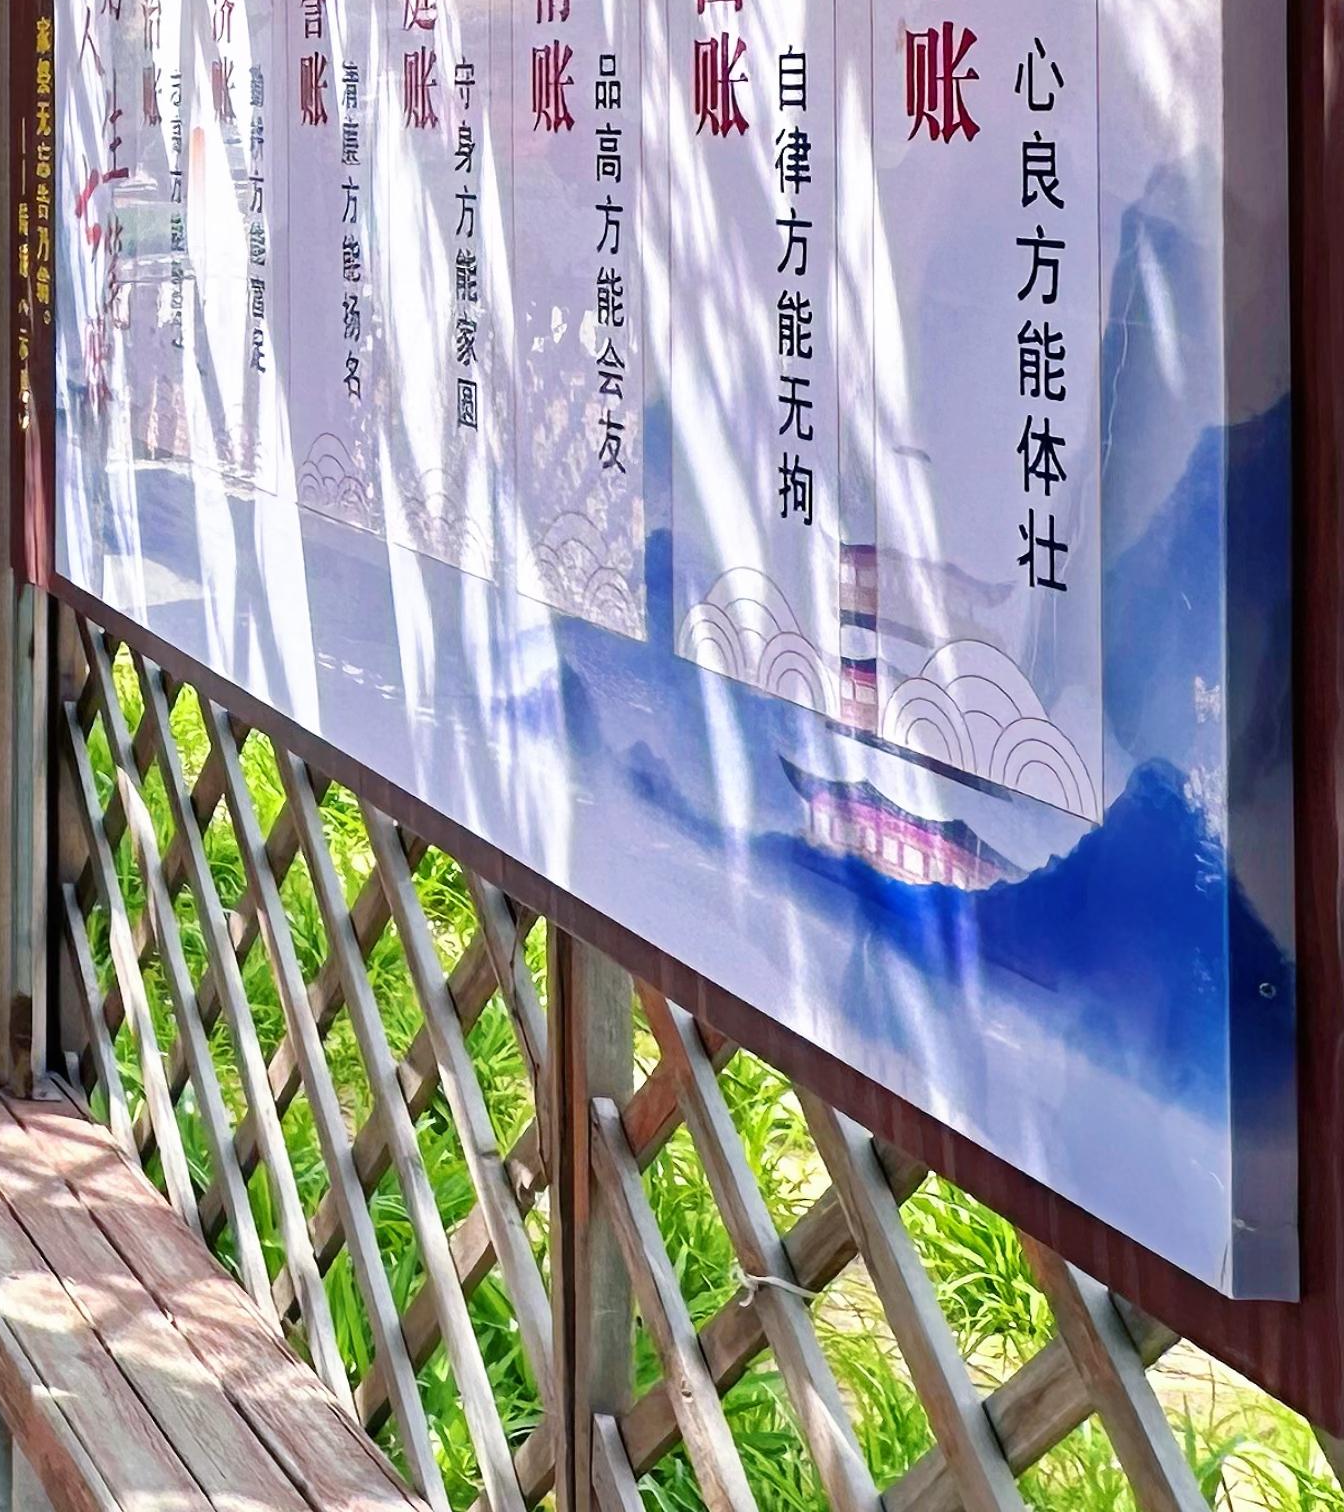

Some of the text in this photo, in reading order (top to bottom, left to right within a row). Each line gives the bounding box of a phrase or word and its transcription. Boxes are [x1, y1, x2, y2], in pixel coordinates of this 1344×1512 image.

[341, 59, 361, 401] 清廉方能扬名
[454, 56, 478, 432] 守身方能家圆
[594, 53, 627, 475] 品高方能会友
[774, 42, 815, 528] 自律方能无拘
[1014, 37, 1069, 593] 心良方能体壮
